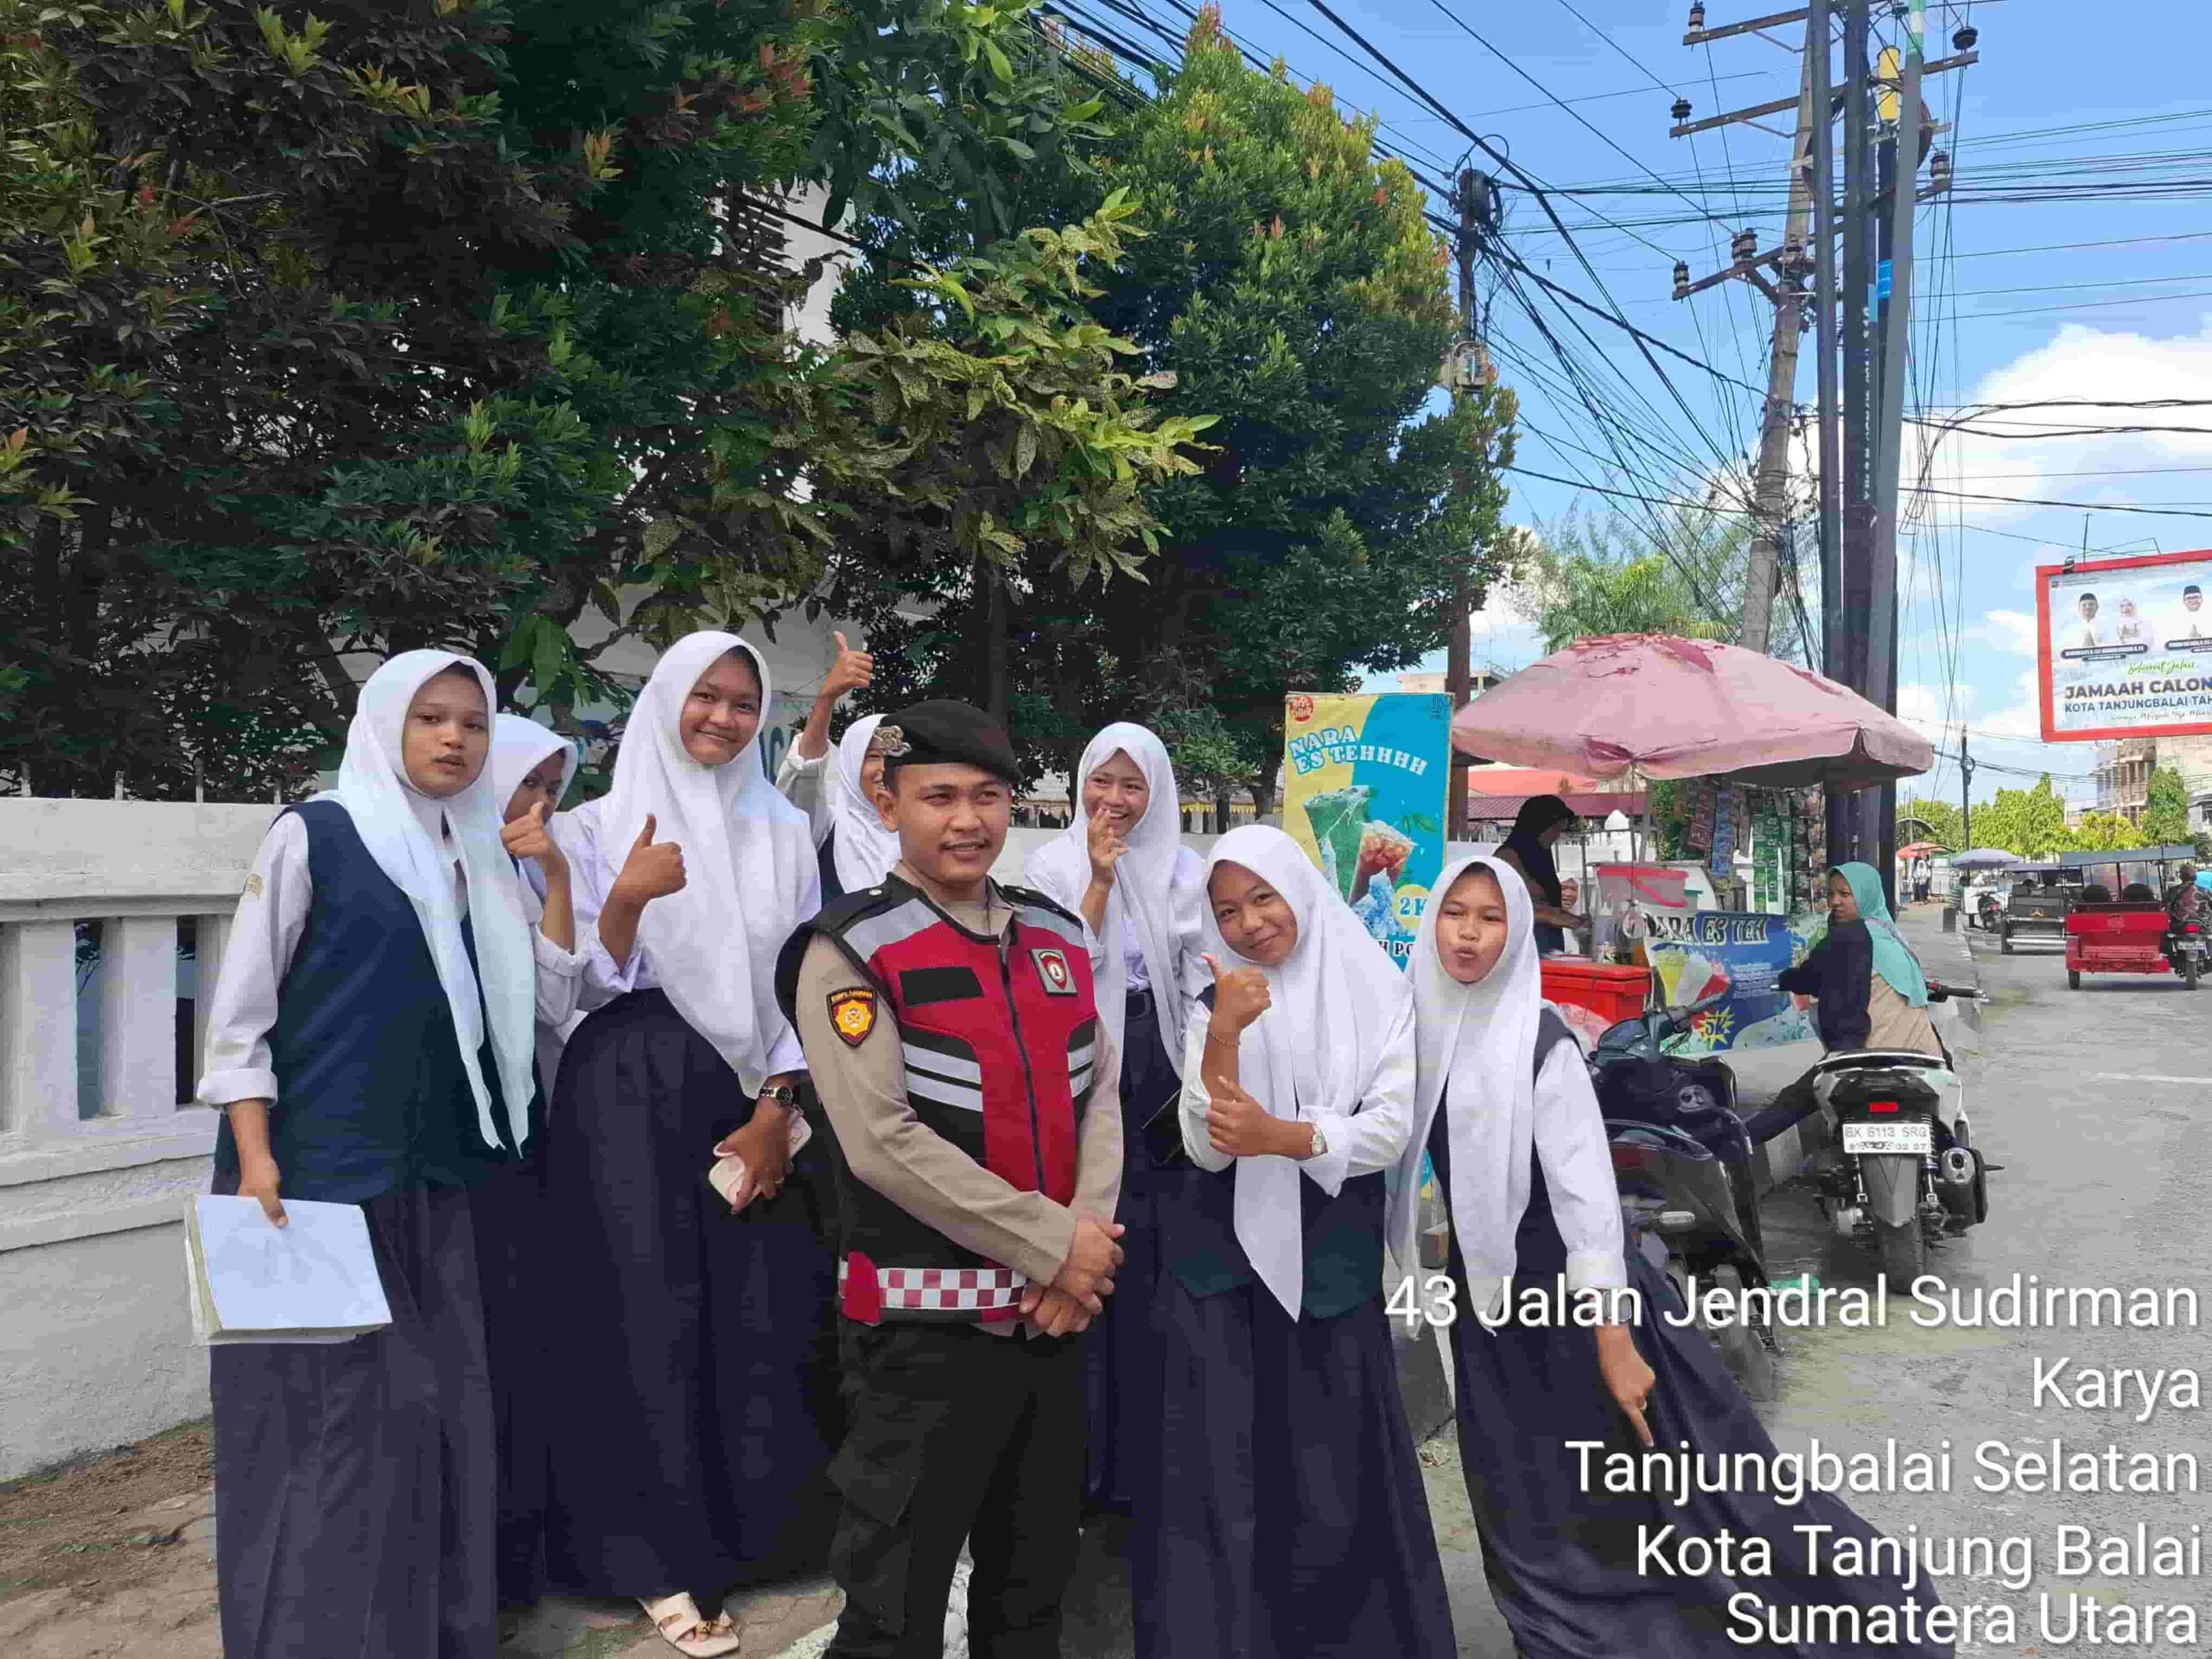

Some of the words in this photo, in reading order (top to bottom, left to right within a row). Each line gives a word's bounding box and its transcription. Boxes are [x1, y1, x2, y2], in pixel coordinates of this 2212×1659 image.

[2065, 682, 2144, 699] JAMAAH
[2149, 677, 2212, 693] CALON
[2065, 702, 2095, 713] KOTA
[2100, 697, 2188, 711] TANJUNGBALAI
[1288, 725, 1358, 758] NARA
[1294, 749, 1325, 774] ES
[1330, 745, 1427, 776] TEHHHH
